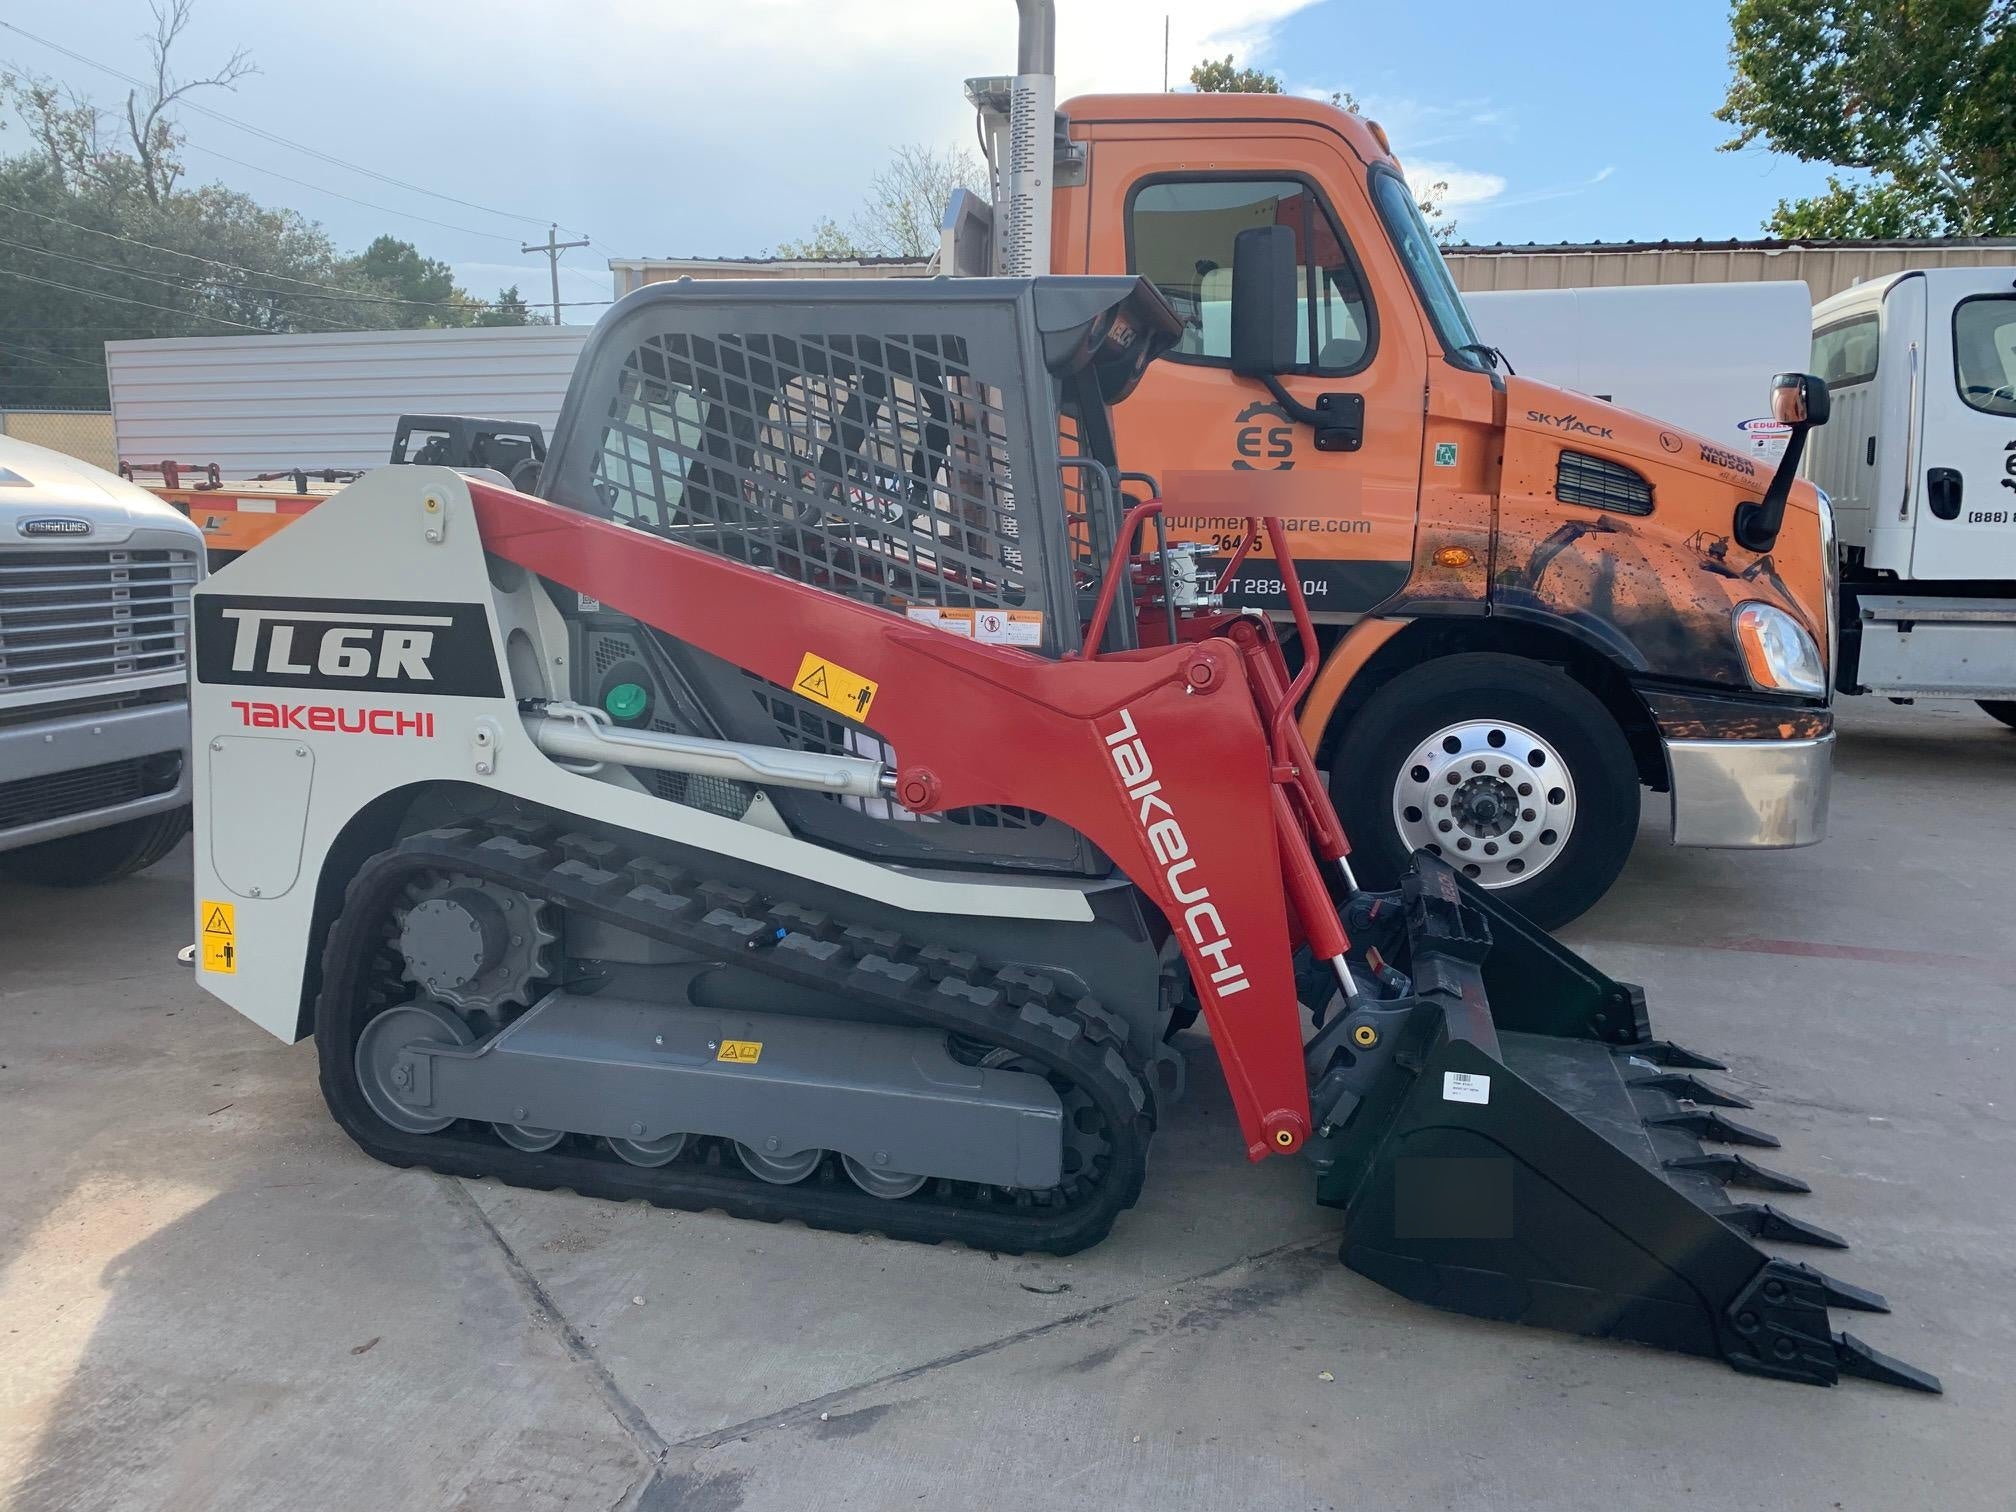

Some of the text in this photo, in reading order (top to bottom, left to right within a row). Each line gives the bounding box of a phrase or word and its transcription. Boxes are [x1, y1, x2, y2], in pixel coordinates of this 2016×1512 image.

[1526, 410, 1613, 439] SKYJACK
[1237, 427, 1293, 457] ES
[1699, 443, 1754, 468] WACKER
[1700, 451, 1755, 477] NEUSON
[29, 521, 88, 533] FREIGHTLINER
[1968, 511, 2008, 523] (888)
[1212, 534, 1263, 551] 2645
[222, 608, 453, 680] TL6R
